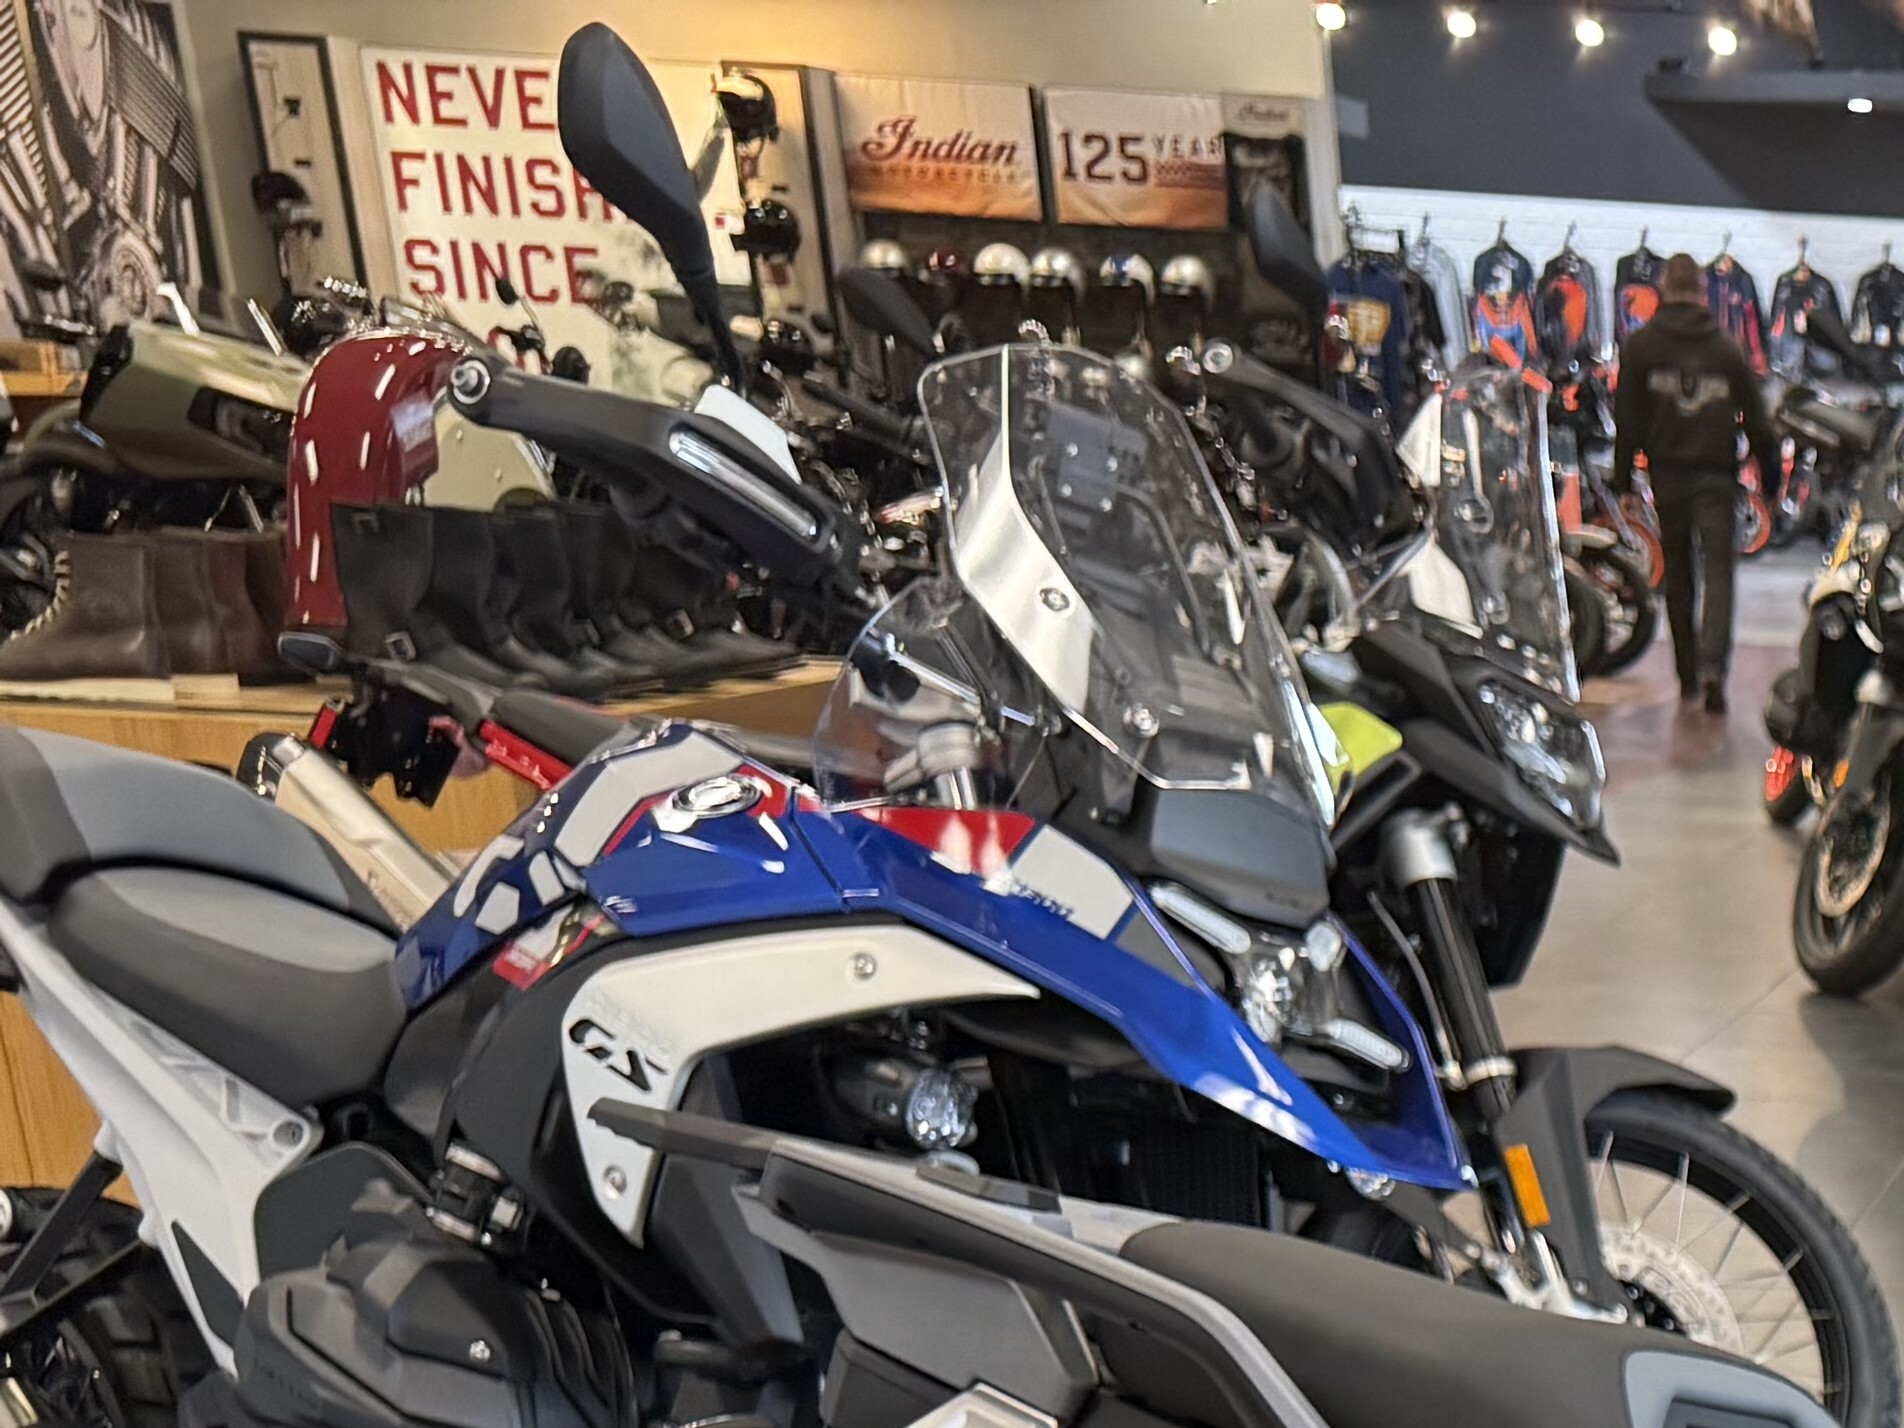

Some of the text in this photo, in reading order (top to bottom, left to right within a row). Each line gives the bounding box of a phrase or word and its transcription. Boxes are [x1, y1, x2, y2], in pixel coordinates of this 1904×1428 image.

[376, 60, 556, 131] NEVE
[862, 115, 1018, 166] Indian
[1060, 132, 1223, 184] 125 YEAR
[404, 238, 600, 305] SINCE
[567, 1017, 669, 1093] GS
